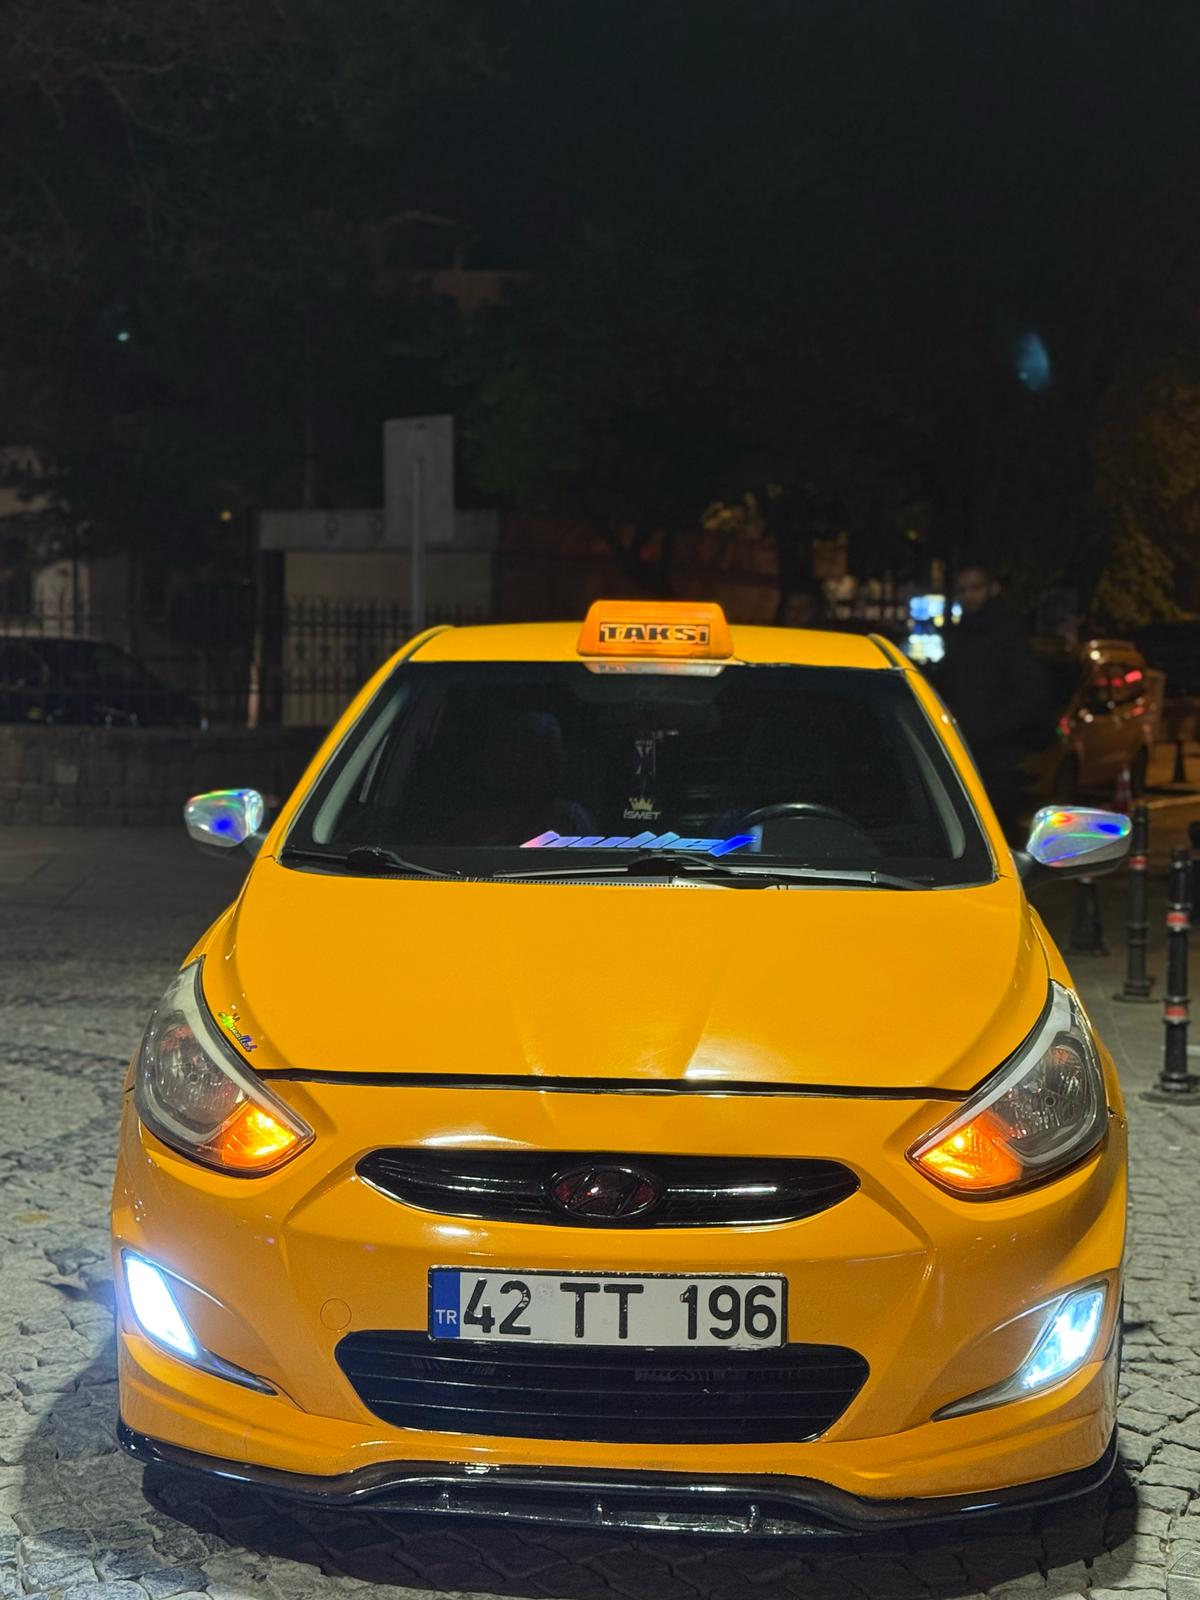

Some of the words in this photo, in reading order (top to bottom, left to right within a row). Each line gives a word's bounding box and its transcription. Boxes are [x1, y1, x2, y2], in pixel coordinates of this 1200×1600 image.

[435, 1309, 457, 1325] TR
[463, 1277, 532, 1335] 42
[560, 1282, 644, 1339] TT
[680, 1284, 777, 1340] 196
